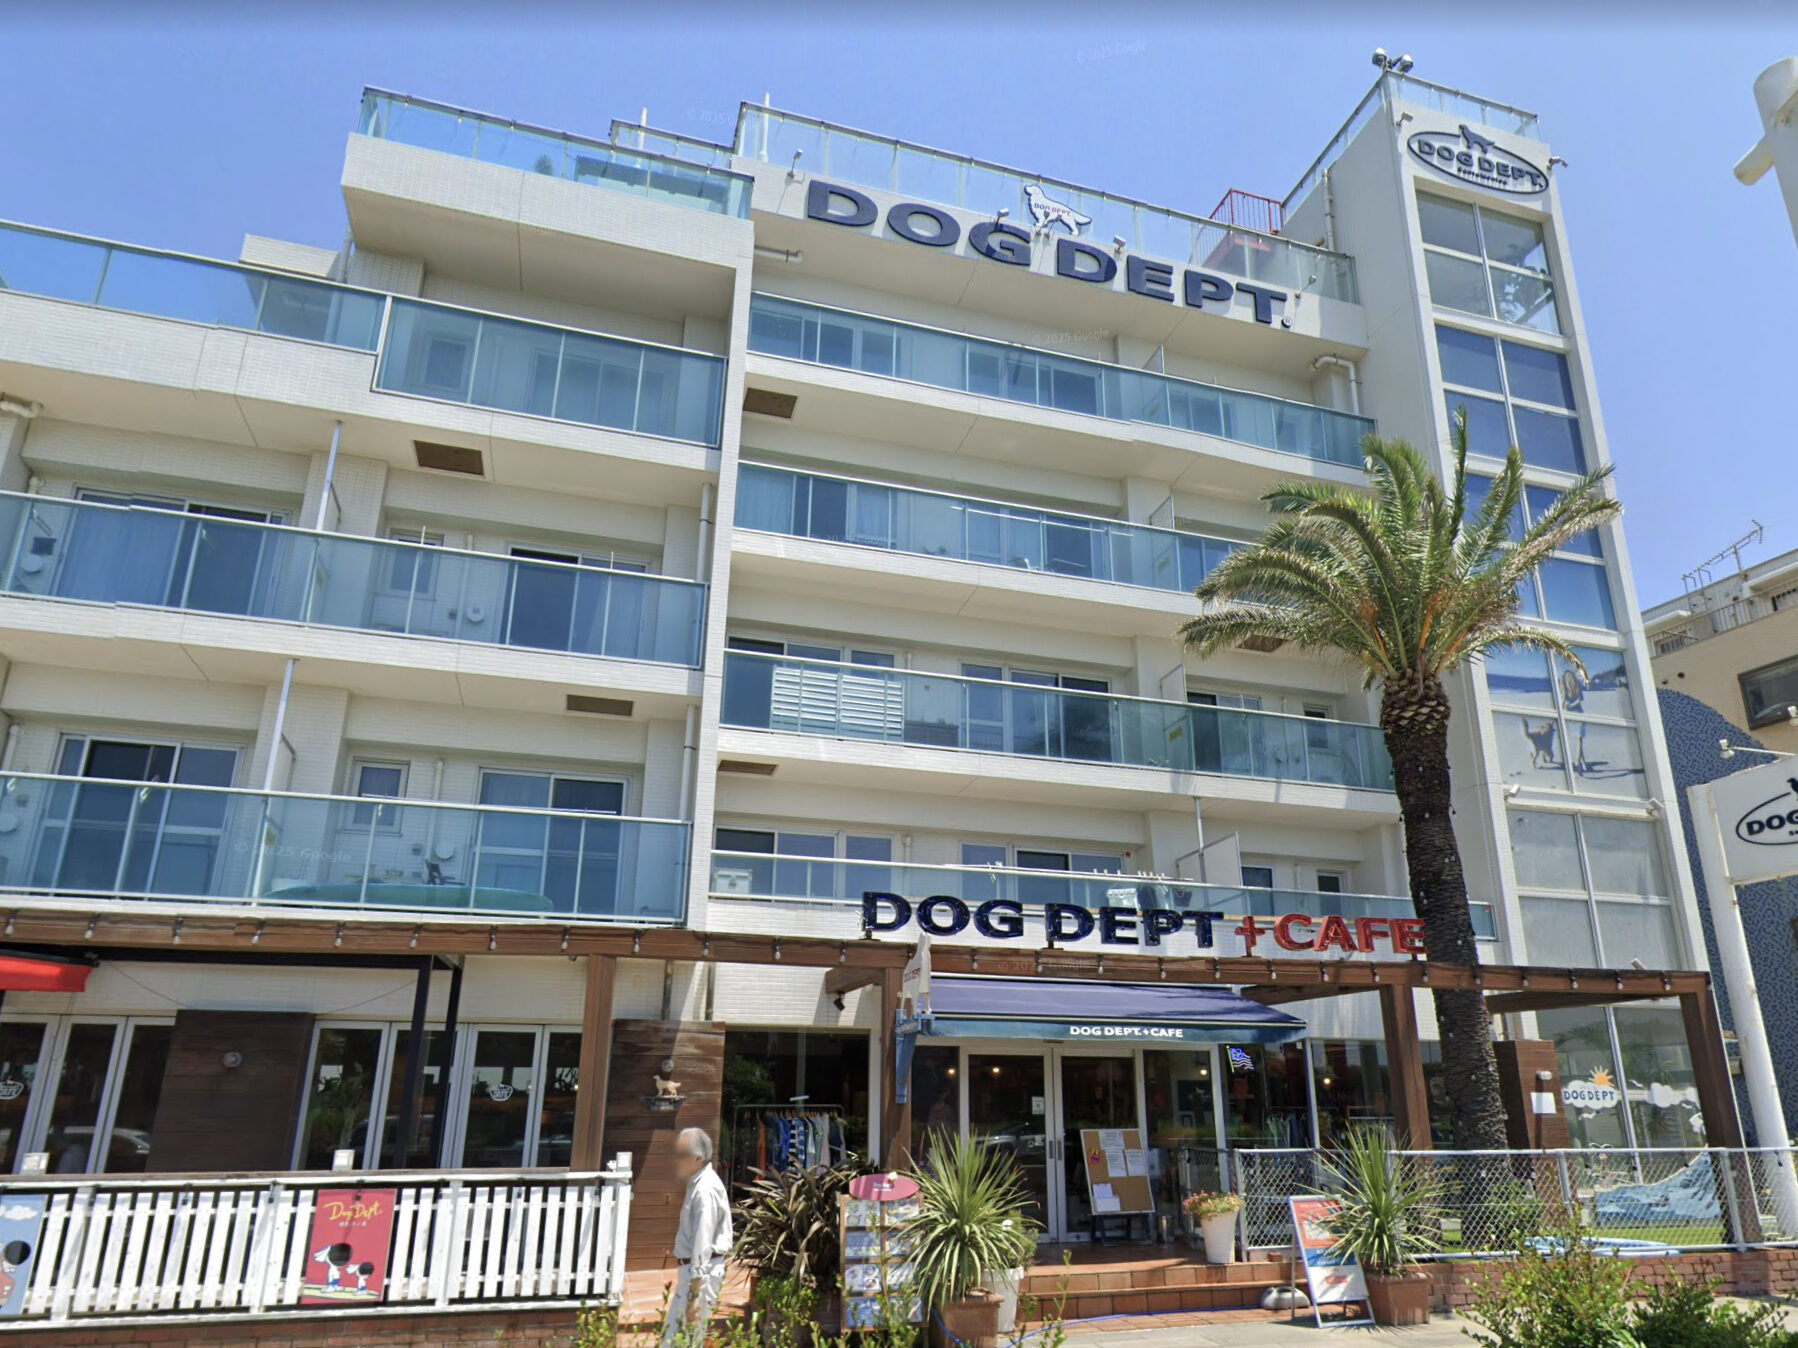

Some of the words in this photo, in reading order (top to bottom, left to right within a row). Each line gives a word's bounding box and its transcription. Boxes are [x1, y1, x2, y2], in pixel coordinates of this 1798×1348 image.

[1417, 138, 1474, 167] DOG
[807, 179, 1031, 266] DOG
[862, 891, 1024, 938] DOG
[1045, 902, 1224, 949] DEPT
[1069, 1026, 1102, 1036] DOG
[1563, 1089, 1586, 1101] DOG
[1588, 1089, 1615, 1102] DEPT
